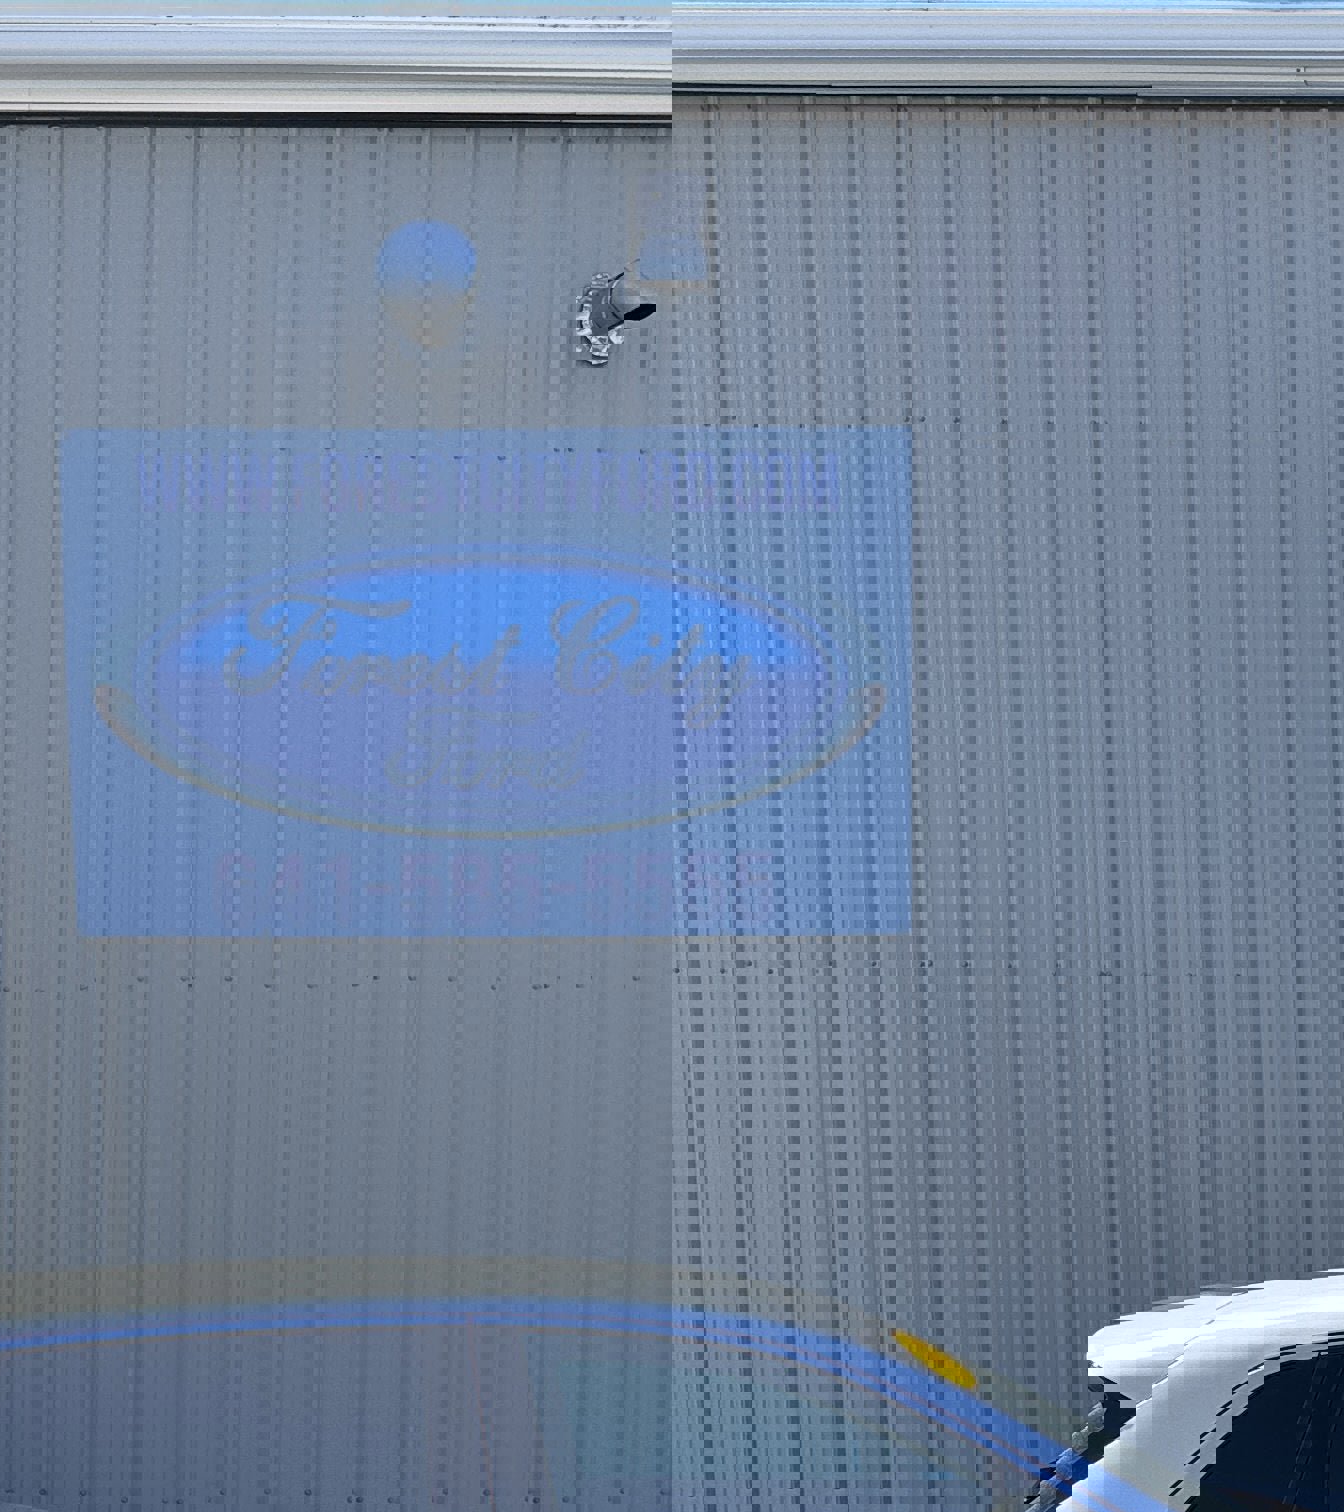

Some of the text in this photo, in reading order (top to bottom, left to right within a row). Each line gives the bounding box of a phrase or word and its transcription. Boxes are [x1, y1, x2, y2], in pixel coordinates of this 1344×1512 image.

[134, 449, 840, 514] WWW.FORESTCITYFORD.COM
[221, 593, 756, 729] Forest City
[385, 705, 593, 788] Ford
